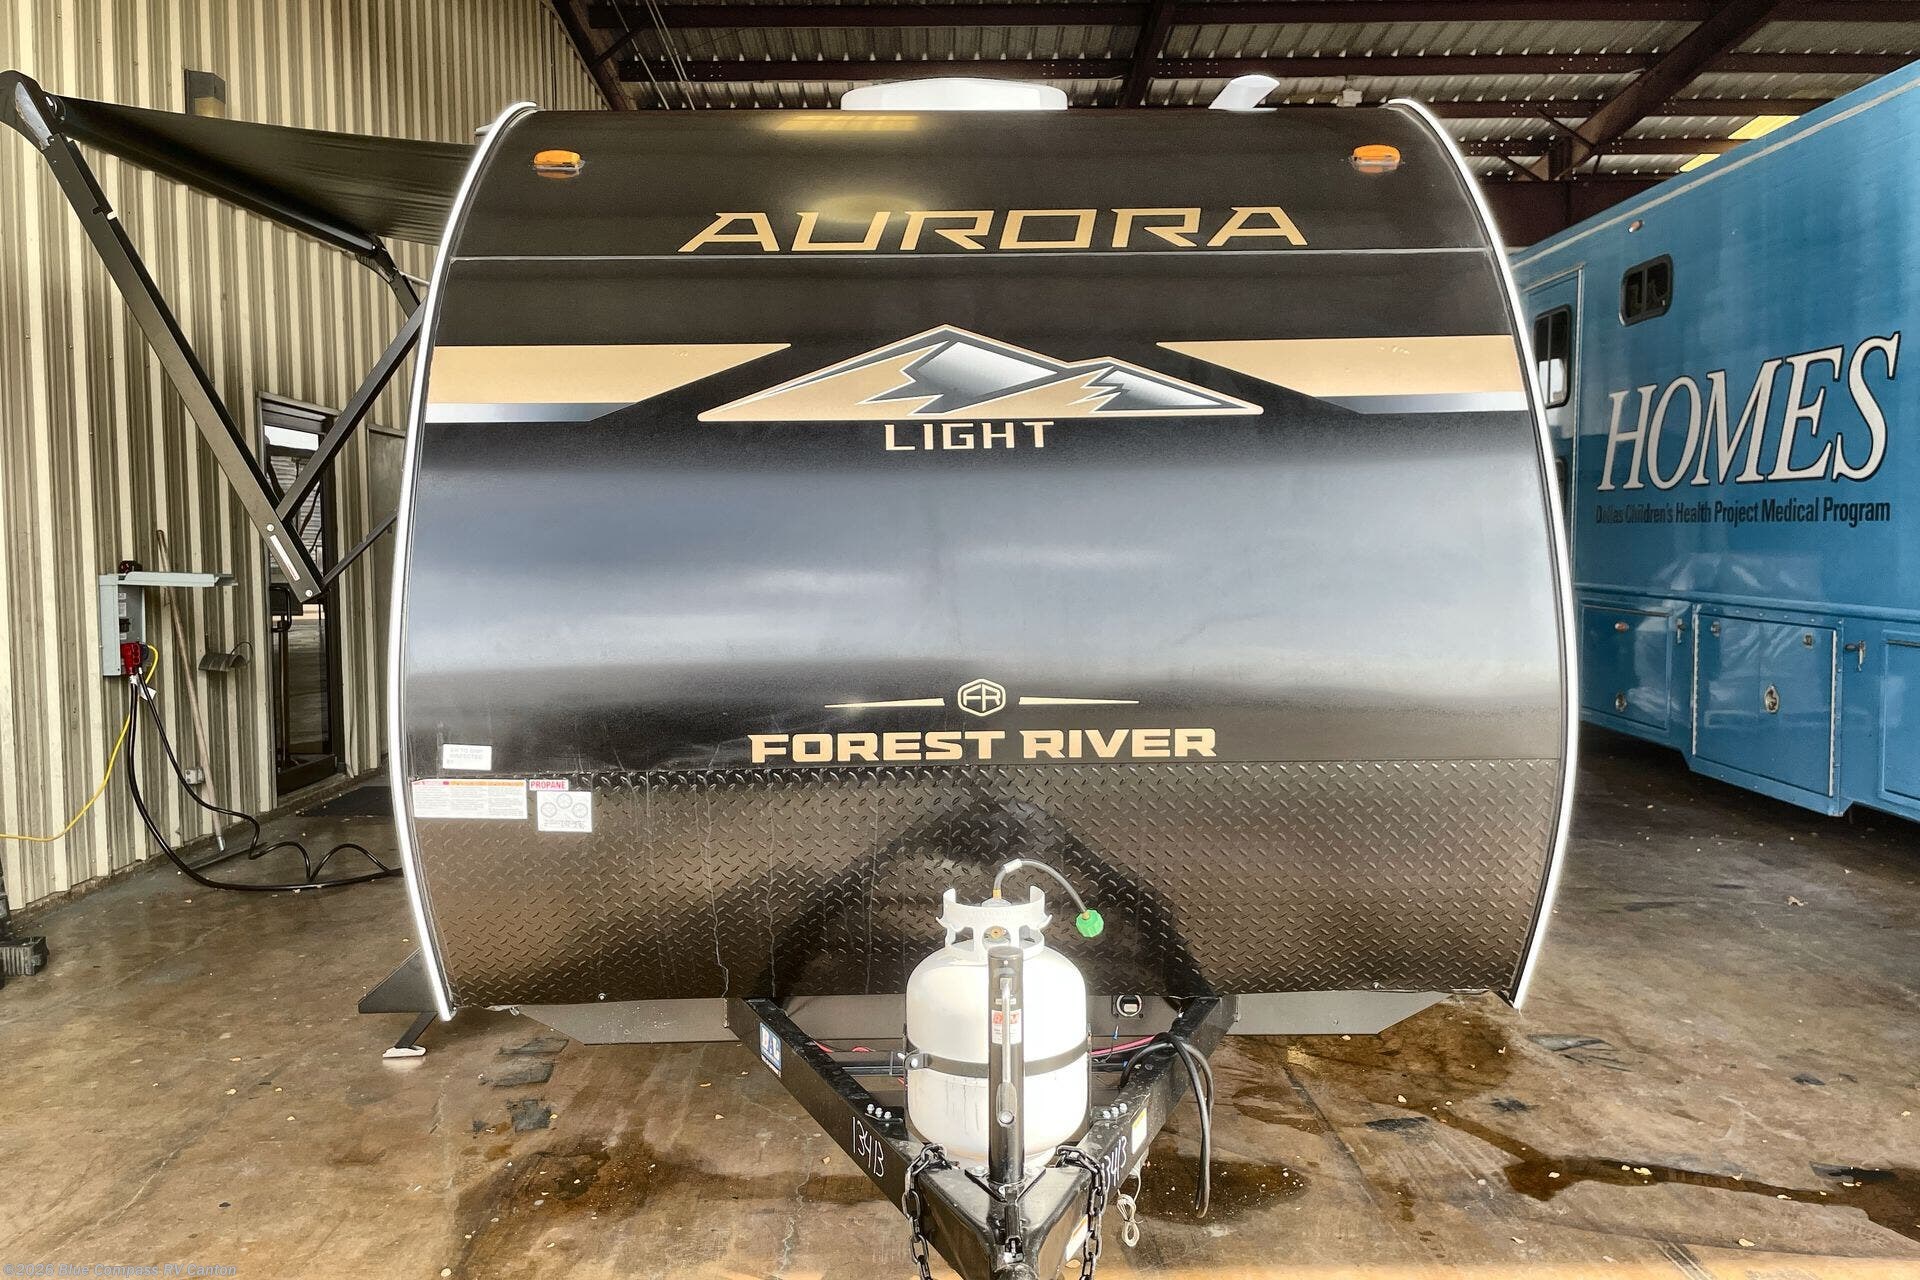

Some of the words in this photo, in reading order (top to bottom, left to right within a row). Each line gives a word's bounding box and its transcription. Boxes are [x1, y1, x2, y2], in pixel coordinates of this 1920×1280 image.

[678, 206, 1308, 252] AURORA
[1597, 330, 1901, 491] HOMES
[885, 421, 1054, 451] LIGHT
[1625, 502, 1673, 524] Children's
[1675, 501, 1712, 523] Health
[1715, 500, 1758, 528] Project
[1762, 497, 1819, 522] Medical
[1823, 497, 1891, 528] Program
[747, 730, 1006, 763] FOREST
[1020, 728, 1217, 758] RIVER
[530, 780, 567, 790] PROPANE
